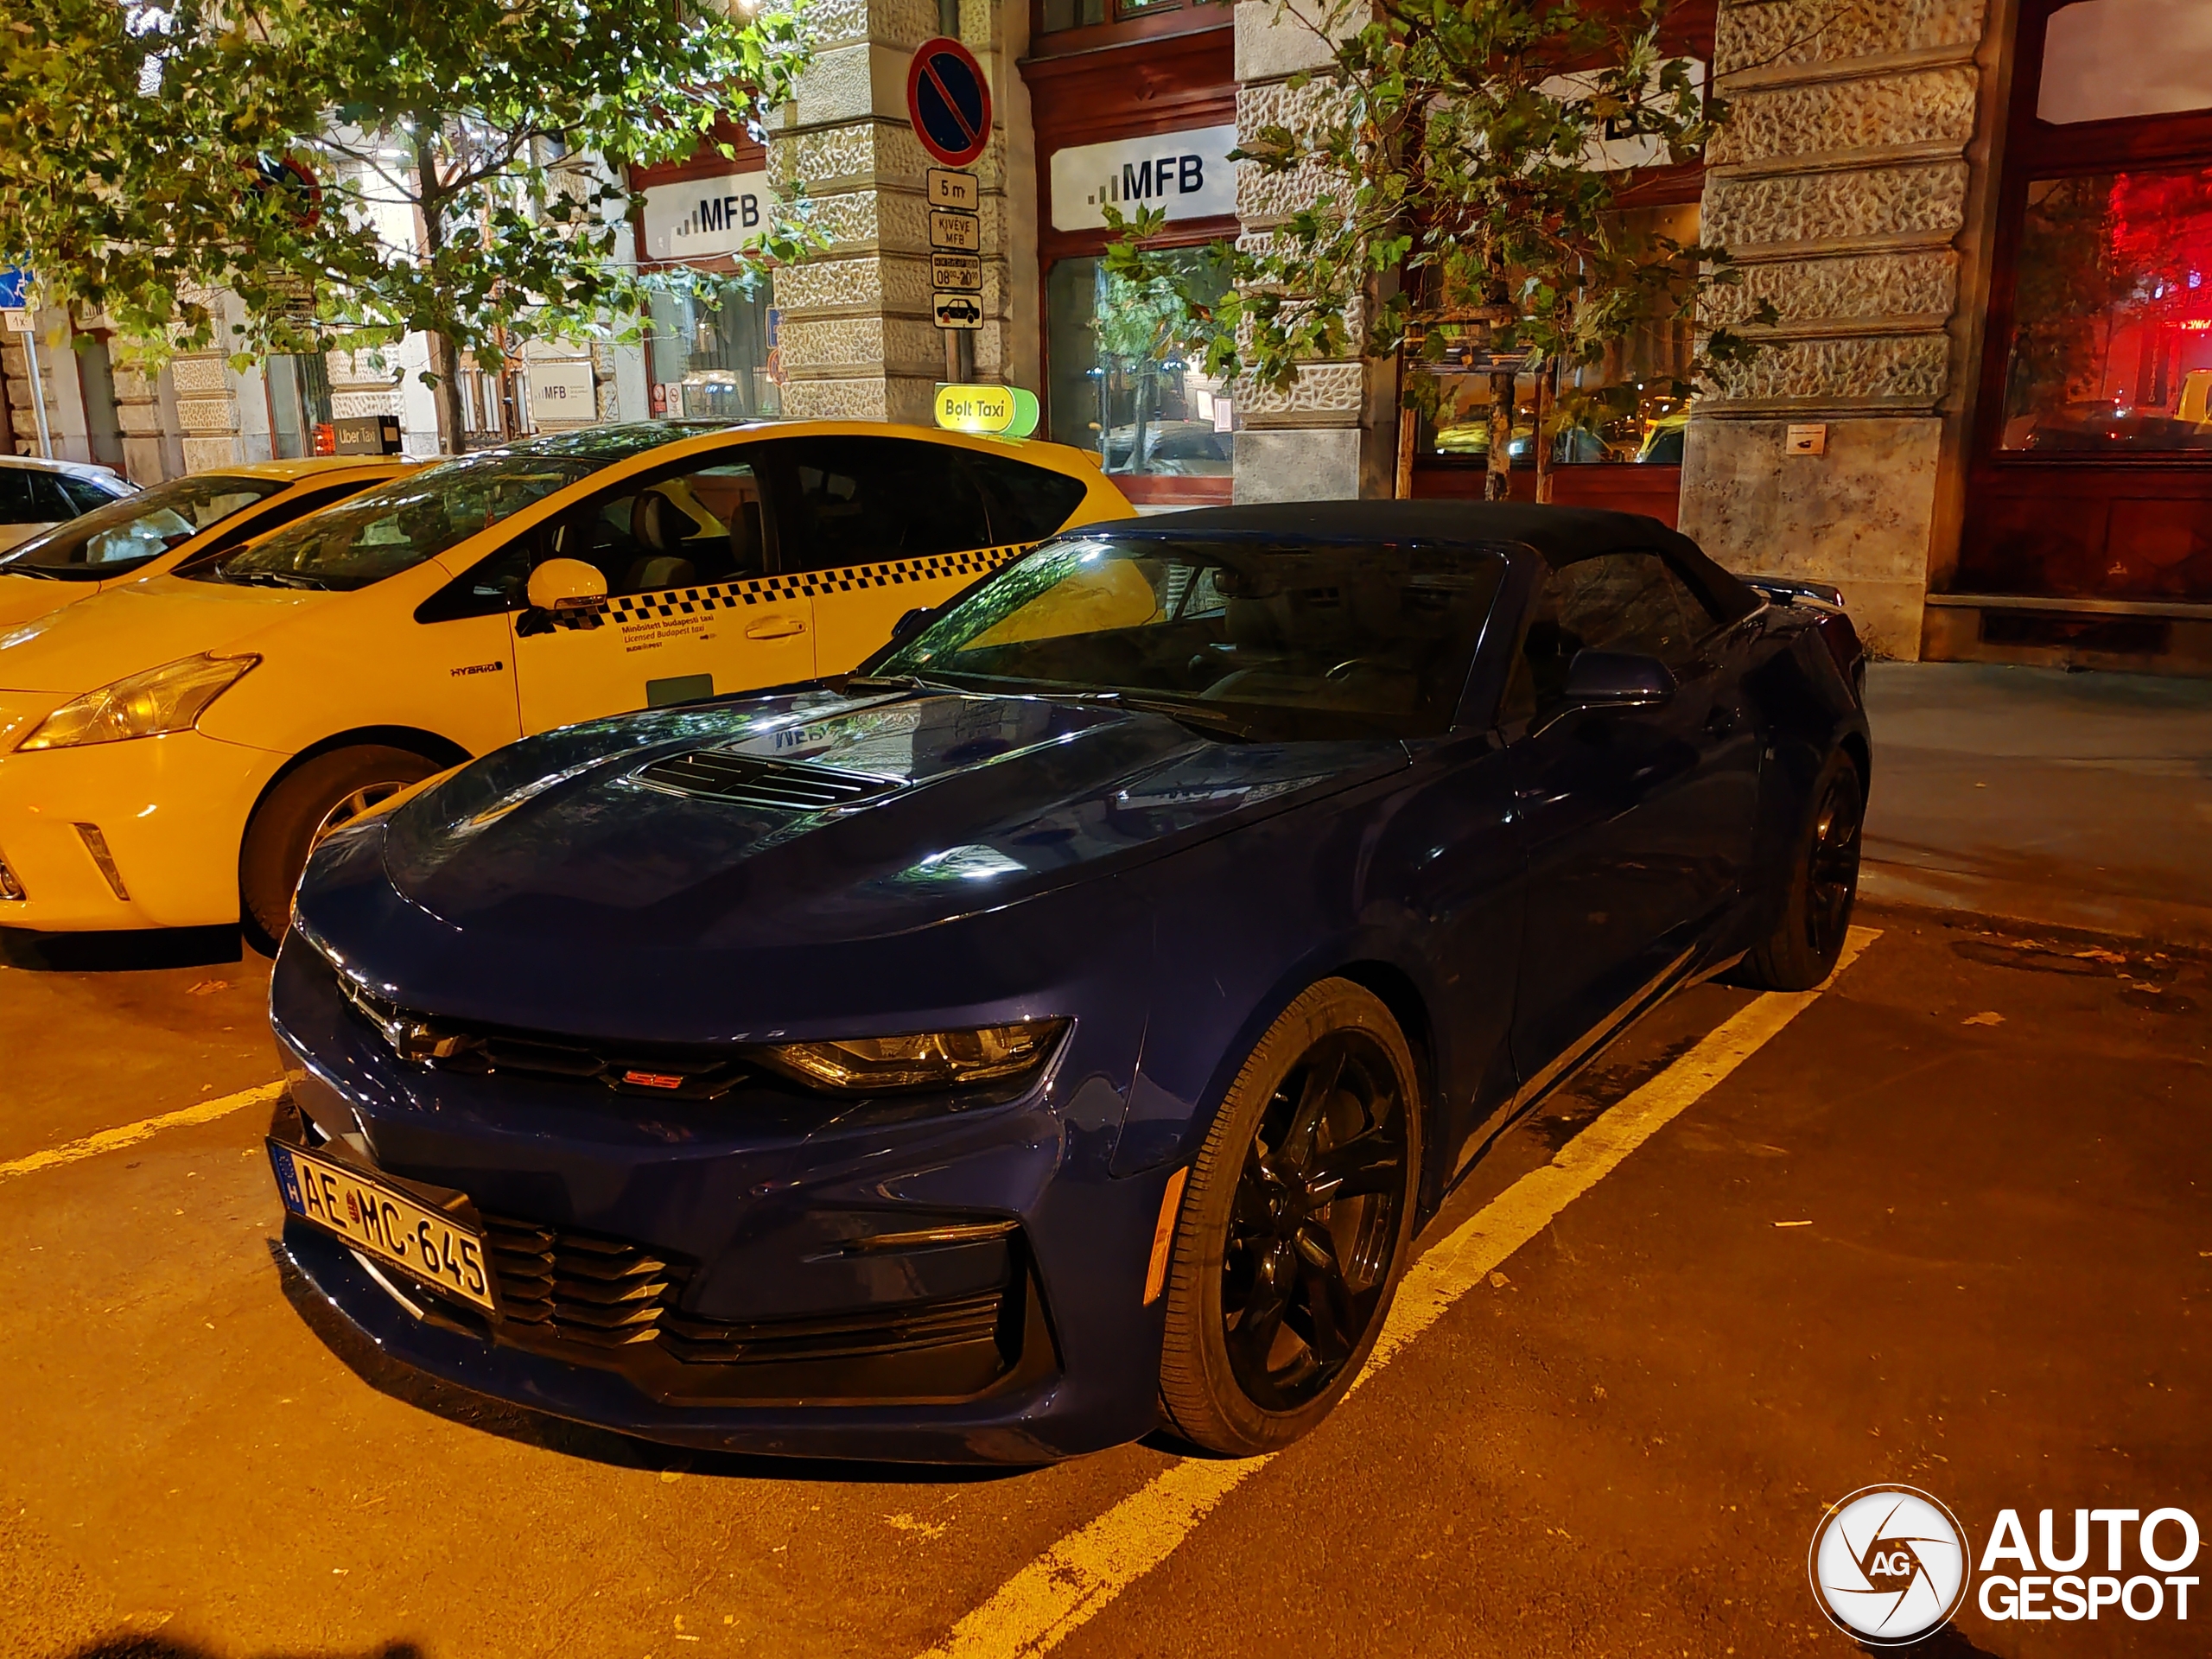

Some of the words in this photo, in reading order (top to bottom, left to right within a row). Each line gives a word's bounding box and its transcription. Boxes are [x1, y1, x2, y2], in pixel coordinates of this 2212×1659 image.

[1123, 154, 1204, 200] MFB
[941, 179, 949, 196] 5
[952, 185, 965, 199] m
[700, 194, 760, 232] MFB
[945, 232, 964, 245] MFB
[544, 385, 567, 399] MFB
[945, 399, 972, 416] Bolt
[976, 399, 1004, 416] Taxi
[339, 428, 359, 444] Uber
[359, 427, 376, 442] Taxi
[662, 615, 699, 627] budapesti
[700, 613, 715, 622] taxi
[624, 632, 656, 643] Licensed
[657, 626, 690, 638] Budapest
[691, 624, 705, 632] taxi
[450, 663, 497, 677] HYBRID
[622, 1071, 682, 1089] SS
[287, 1183, 301, 1204] H
[302, 1163, 351, 1230] AE
